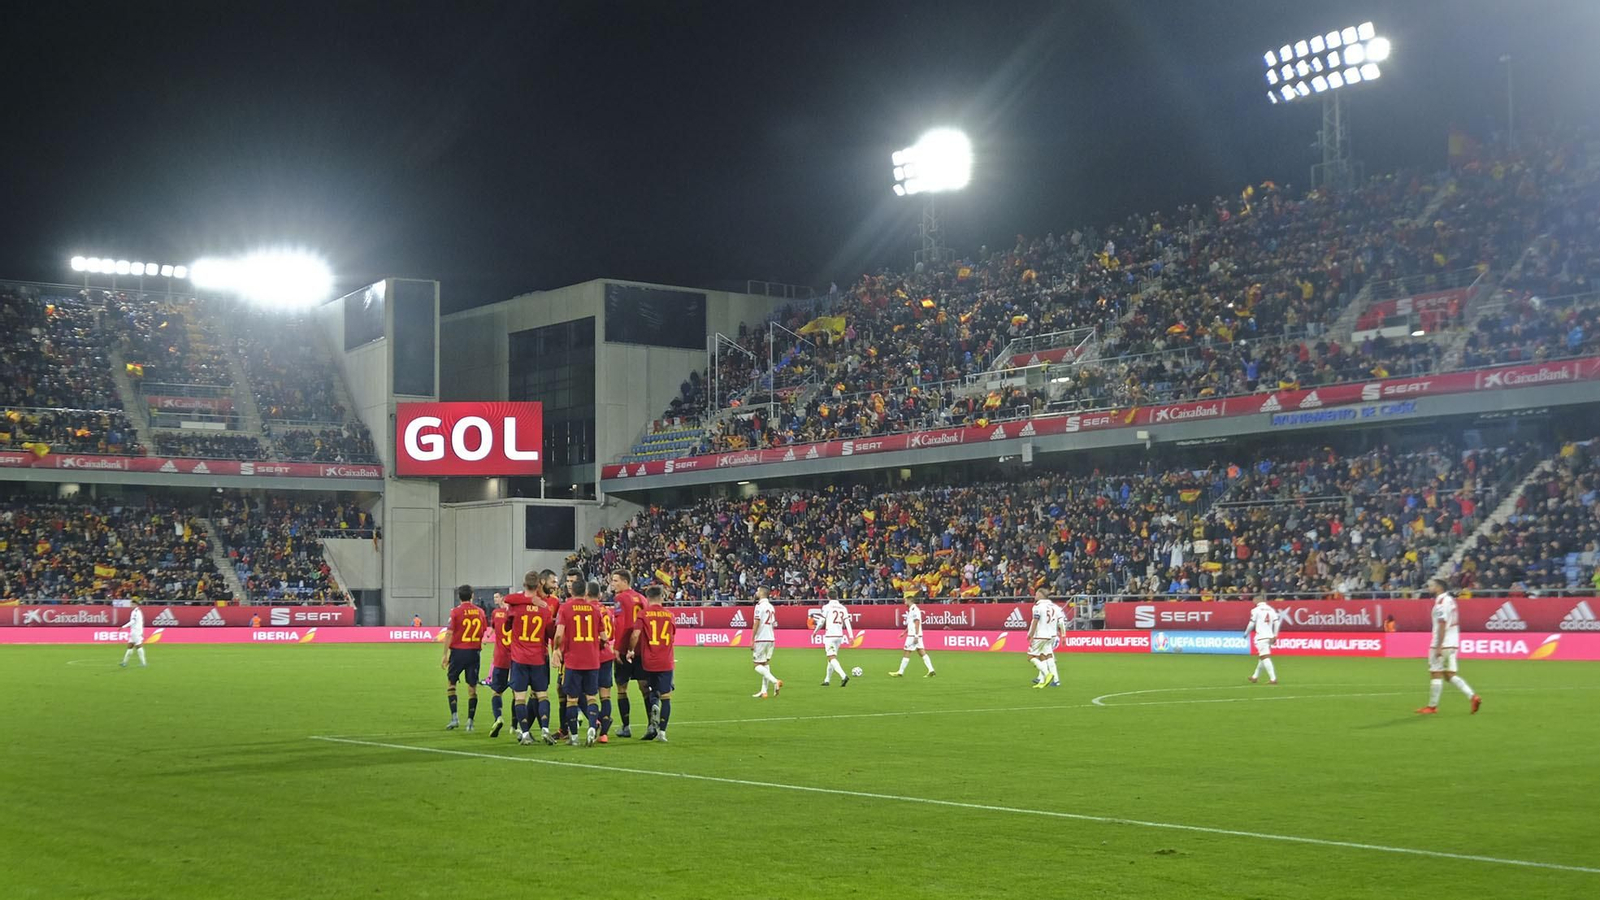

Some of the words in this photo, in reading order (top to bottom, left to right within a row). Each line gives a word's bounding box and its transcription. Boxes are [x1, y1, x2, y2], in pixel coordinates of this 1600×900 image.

[1503, 366, 1570, 385] CaixaBank
[1384, 382, 1432, 395] SEAT
[1169, 405, 1218, 420] CaixaBank
[1083, 417, 1109, 427] SEA
[404, 416, 538, 461] GOL
[921, 432, 959, 446] CaixaBank
[855, 441, 882, 451] SEAT
[76, 458, 122, 469] CaixaBank
[675, 461, 698, 469] SEAT
[338, 467, 379, 477] CaixaBank
[43, 608, 109, 624] CaixaBank
[295, 612, 342, 621] SEAT
[675, 613, 698, 625] aBank
[832, 610, 845, 625] 23
[1160, 611, 1213, 622] SEAT
[1264, 613, 1270, 625] 4
[1294, 607, 1371, 625] CaixaBank
[518, 614, 543, 642] 12
[573, 614, 595, 642] 11
[1004, 620, 1028, 628] adidas
[1485, 620, 1527, 630] adidas
[1559, 620, 1600, 630] adidas
[390, 630, 432, 640] IBERIA
[461, 618, 482, 642] 22
[648, 620, 670, 646] 14
[94, 631, 130, 641] IBER
[253, 631, 299, 641] IBERIA
[696, 633, 729, 643] IBERIA
[944, 636, 989, 647] IBERIA
[1066, 637, 1102, 647] UROPEAN
[1104, 636, 1149, 647] QUALIFIERS
[1170, 637, 1195, 648] UEFA
[1195, 637, 1221, 648] EURO
[1222, 637, 1248, 648] 2020
[1324, 639, 1381, 650] QUALIFIERS
[1460, 639, 1529, 654] BERIA
